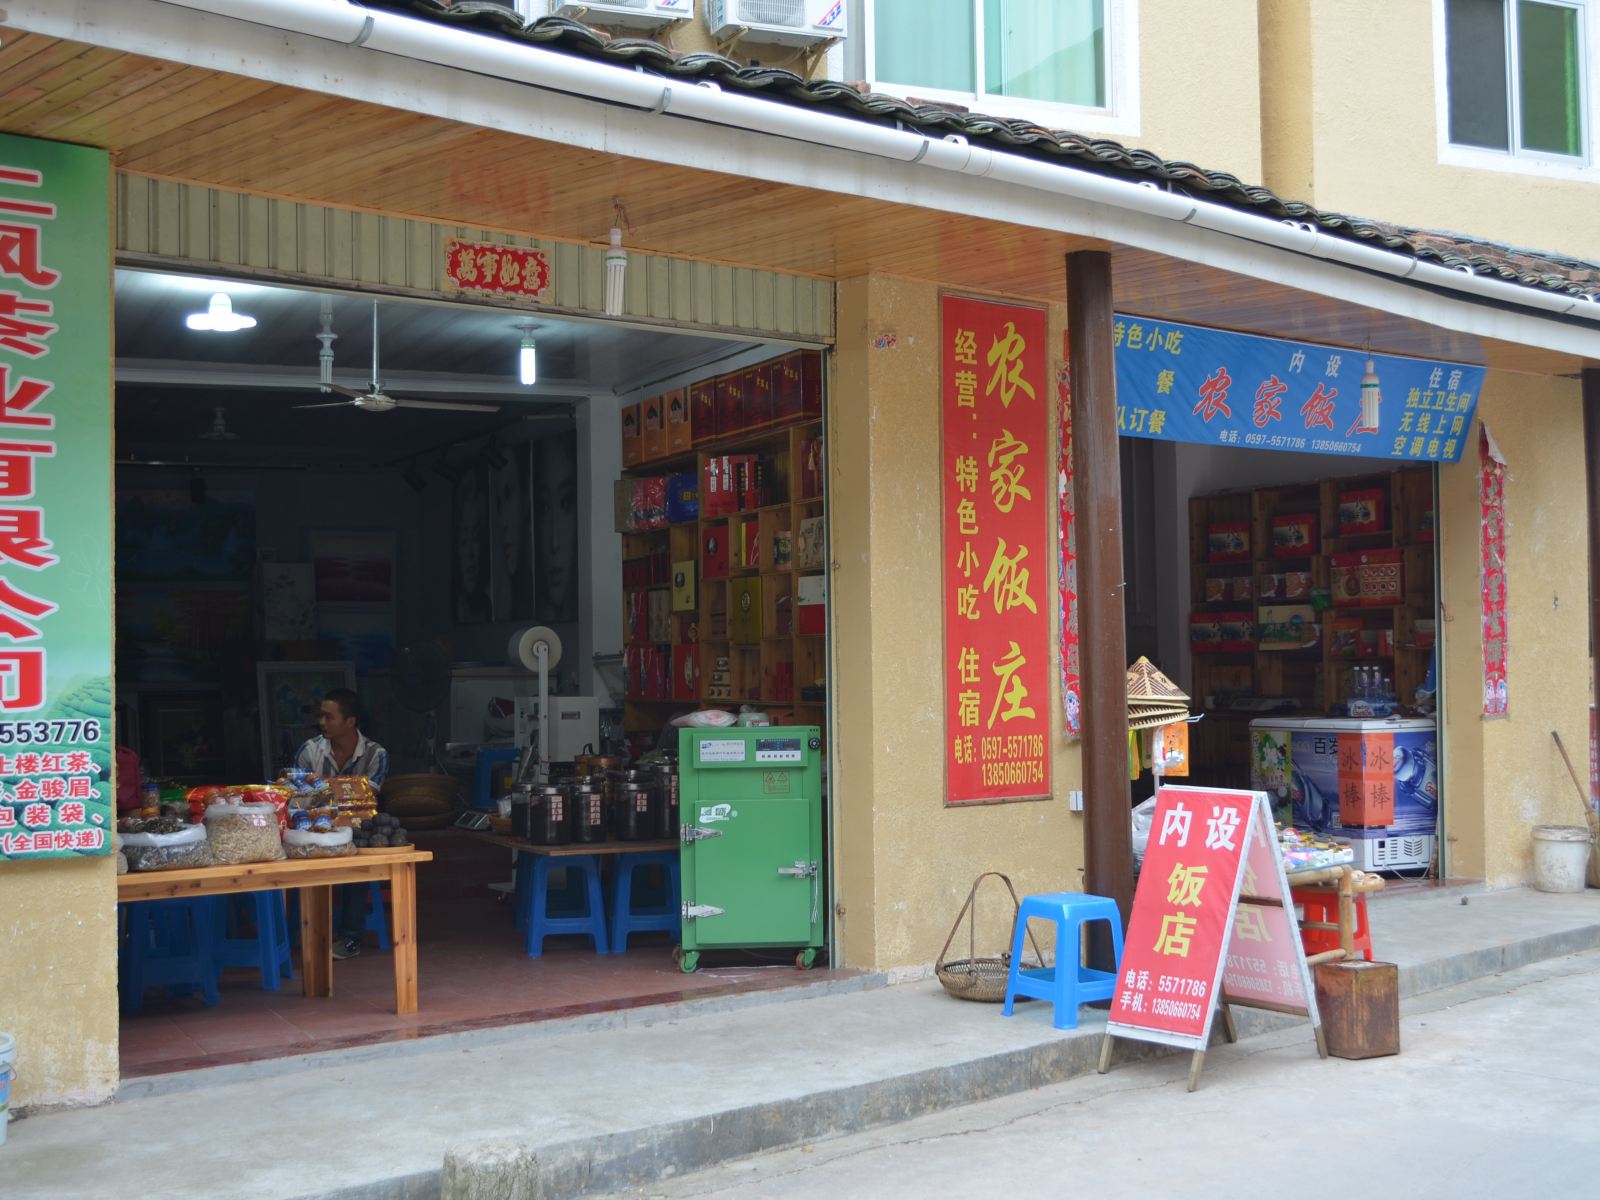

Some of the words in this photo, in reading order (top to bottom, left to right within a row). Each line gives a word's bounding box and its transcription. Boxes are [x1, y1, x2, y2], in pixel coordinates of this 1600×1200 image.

[456, 248, 542, 291] 萬事如意
[1156, 369, 1175, 395] 餐
[1405, 387, 1472, 413] 独立卫生间
[1398, 412, 1464, 436] 无线上网
[1311, 439, 1362, 453] 13850660754
[1391, 435, 1457, 459] 空调电视
[983, 321, 1037, 730] 农家饭庄
[981, 759, 1044, 787] 13850660754
[1159, 802, 1241, 852] 内设
